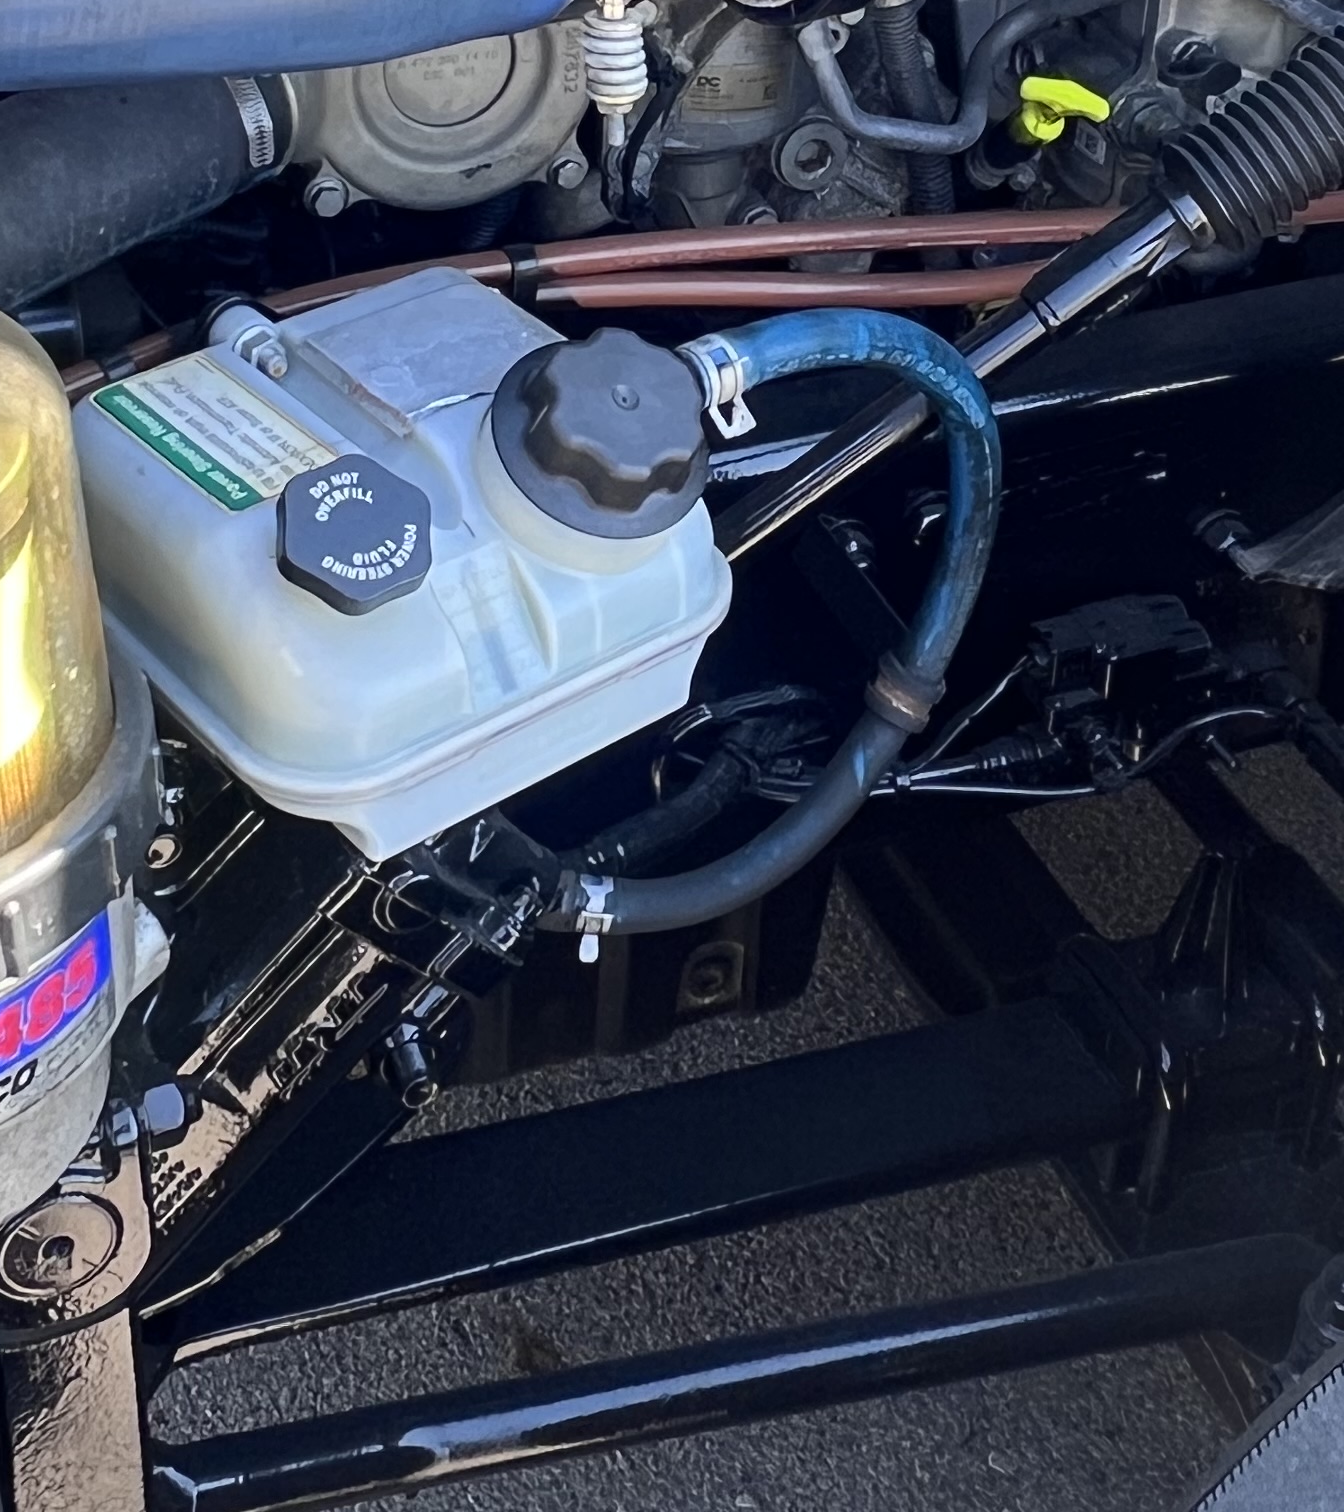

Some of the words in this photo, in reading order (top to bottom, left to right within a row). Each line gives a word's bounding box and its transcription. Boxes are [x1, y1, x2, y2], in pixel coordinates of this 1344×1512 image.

[309, 480, 330, 499] DO
[330, 472, 359, 487] NOT
[315, 487, 373, 522] OVERFILL
[352, 539, 397, 566] FLUID
[390, 524, 417, 568] POWER
[321, 555, 393, 581] STEERING
